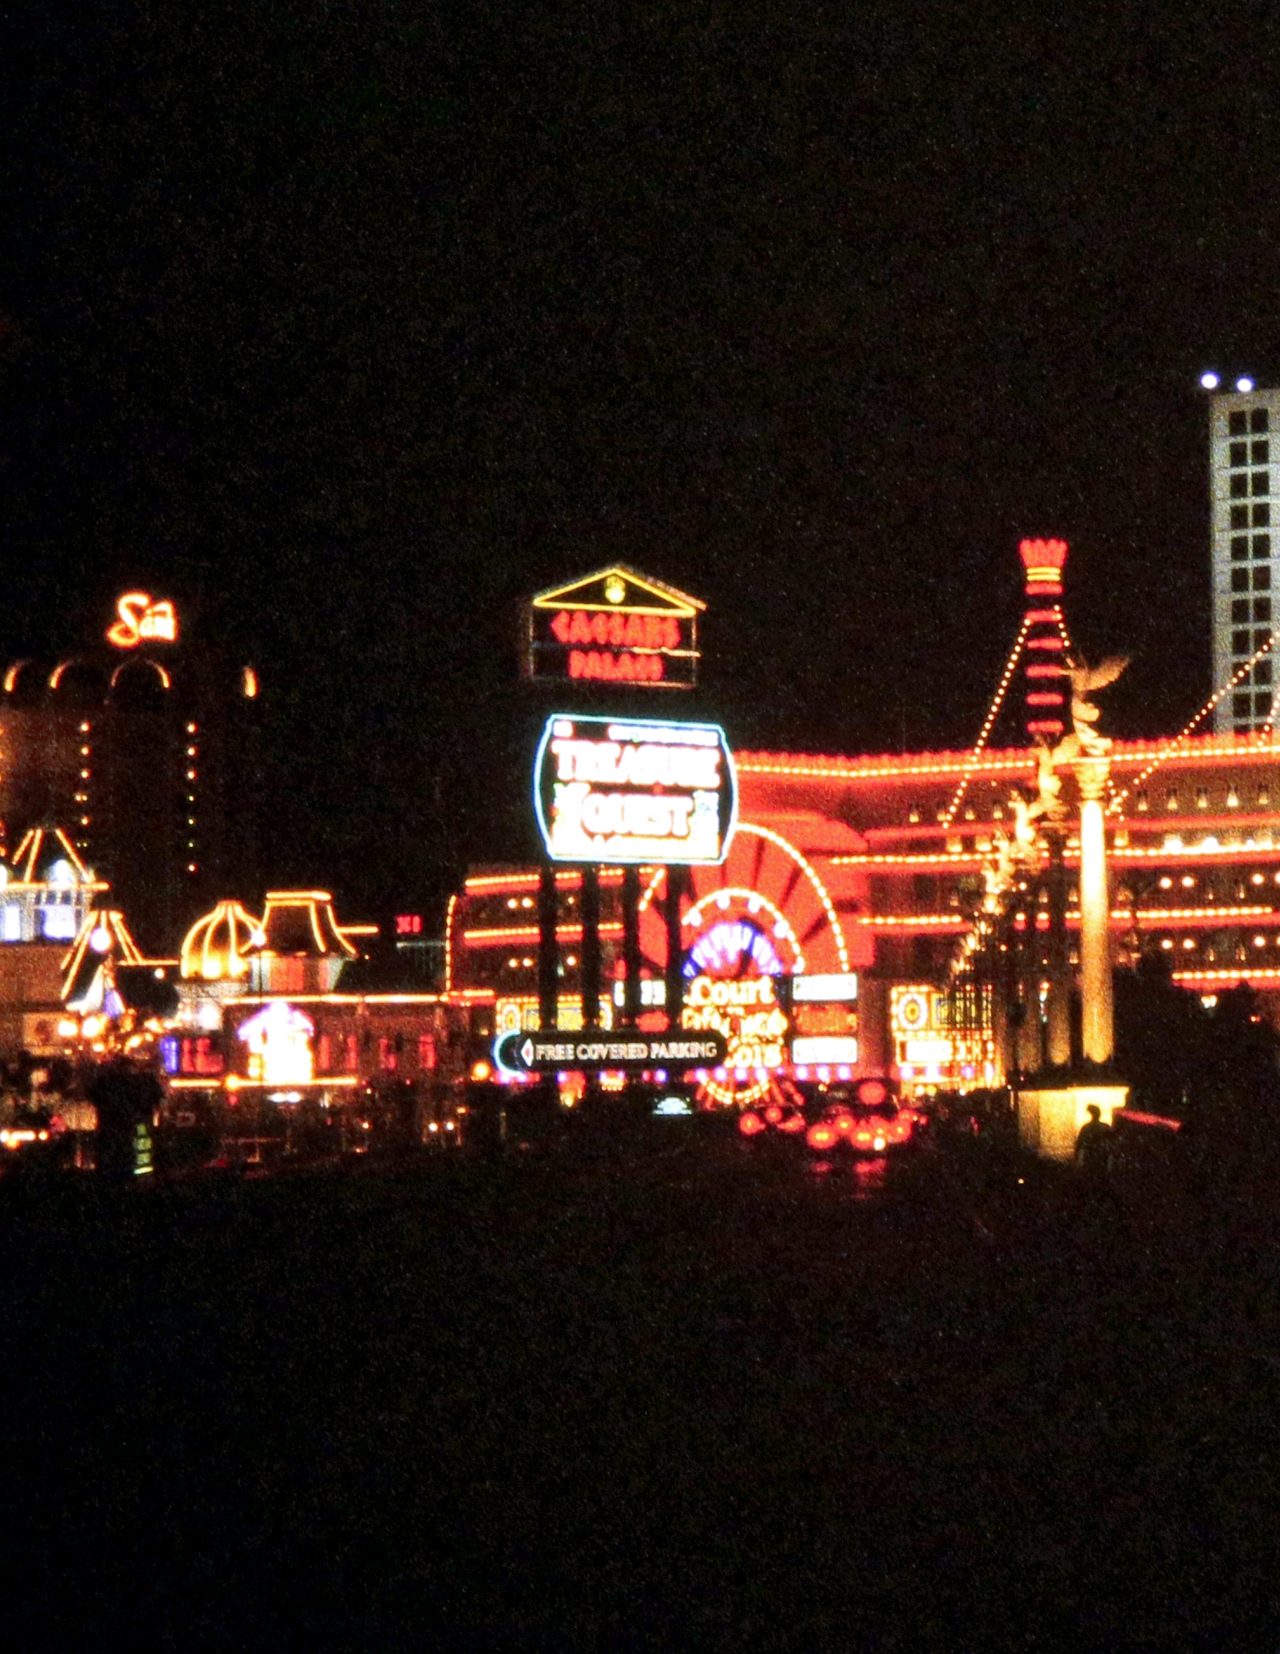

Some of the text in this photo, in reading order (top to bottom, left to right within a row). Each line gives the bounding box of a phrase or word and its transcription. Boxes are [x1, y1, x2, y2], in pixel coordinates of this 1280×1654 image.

[551, 740, 721, 788] TREASURE
[581, 793, 694, 836] QUEST
[682, 975, 775, 1007] Court
[535, 1043, 574, 1060] FREE
[576, 1043, 648, 1060] COVERED
[650, 1042, 717, 1059] PARKING
